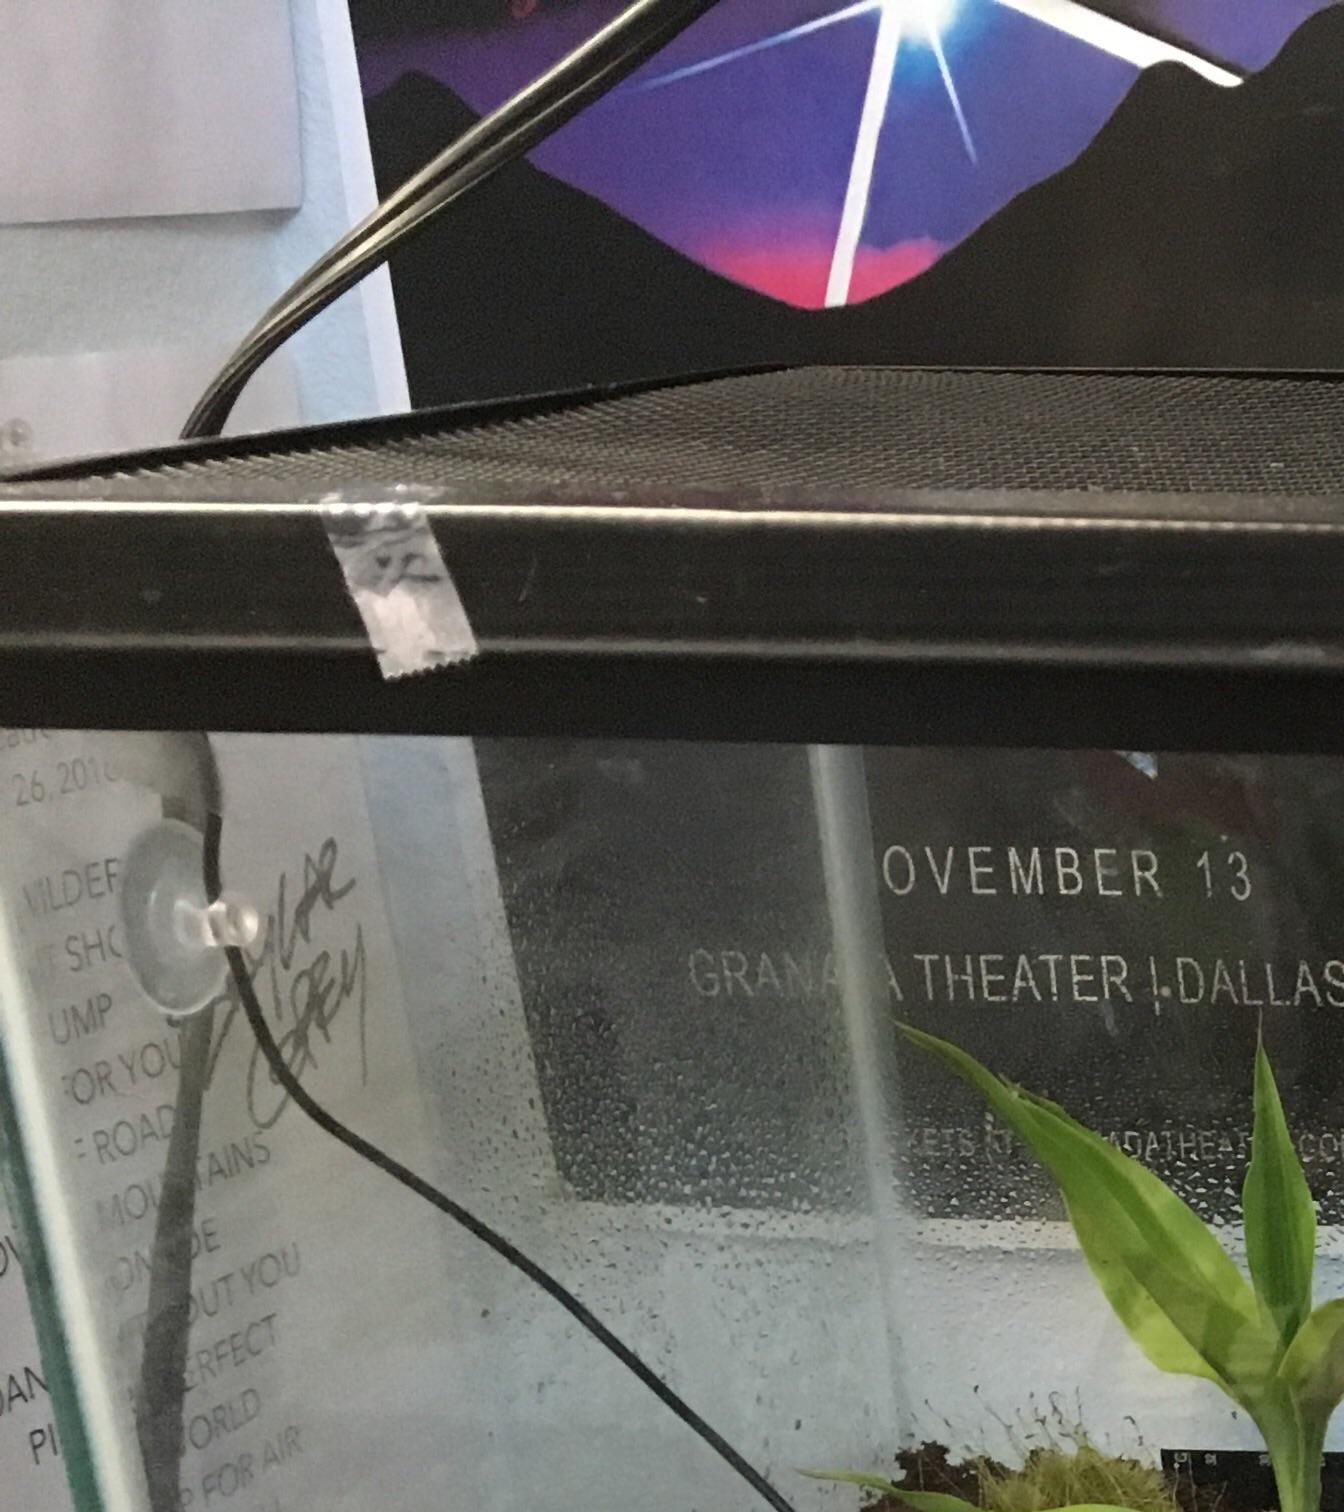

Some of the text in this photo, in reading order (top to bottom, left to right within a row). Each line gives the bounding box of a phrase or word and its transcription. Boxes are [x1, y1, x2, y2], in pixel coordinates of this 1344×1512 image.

[882, 844, 1252, 901] OVEMBER 13
[913, 953, 1133, 1002] THEATER
[49, 993, 113, 1045] UMP
[187, 1387, 261, 1451] ORLD
